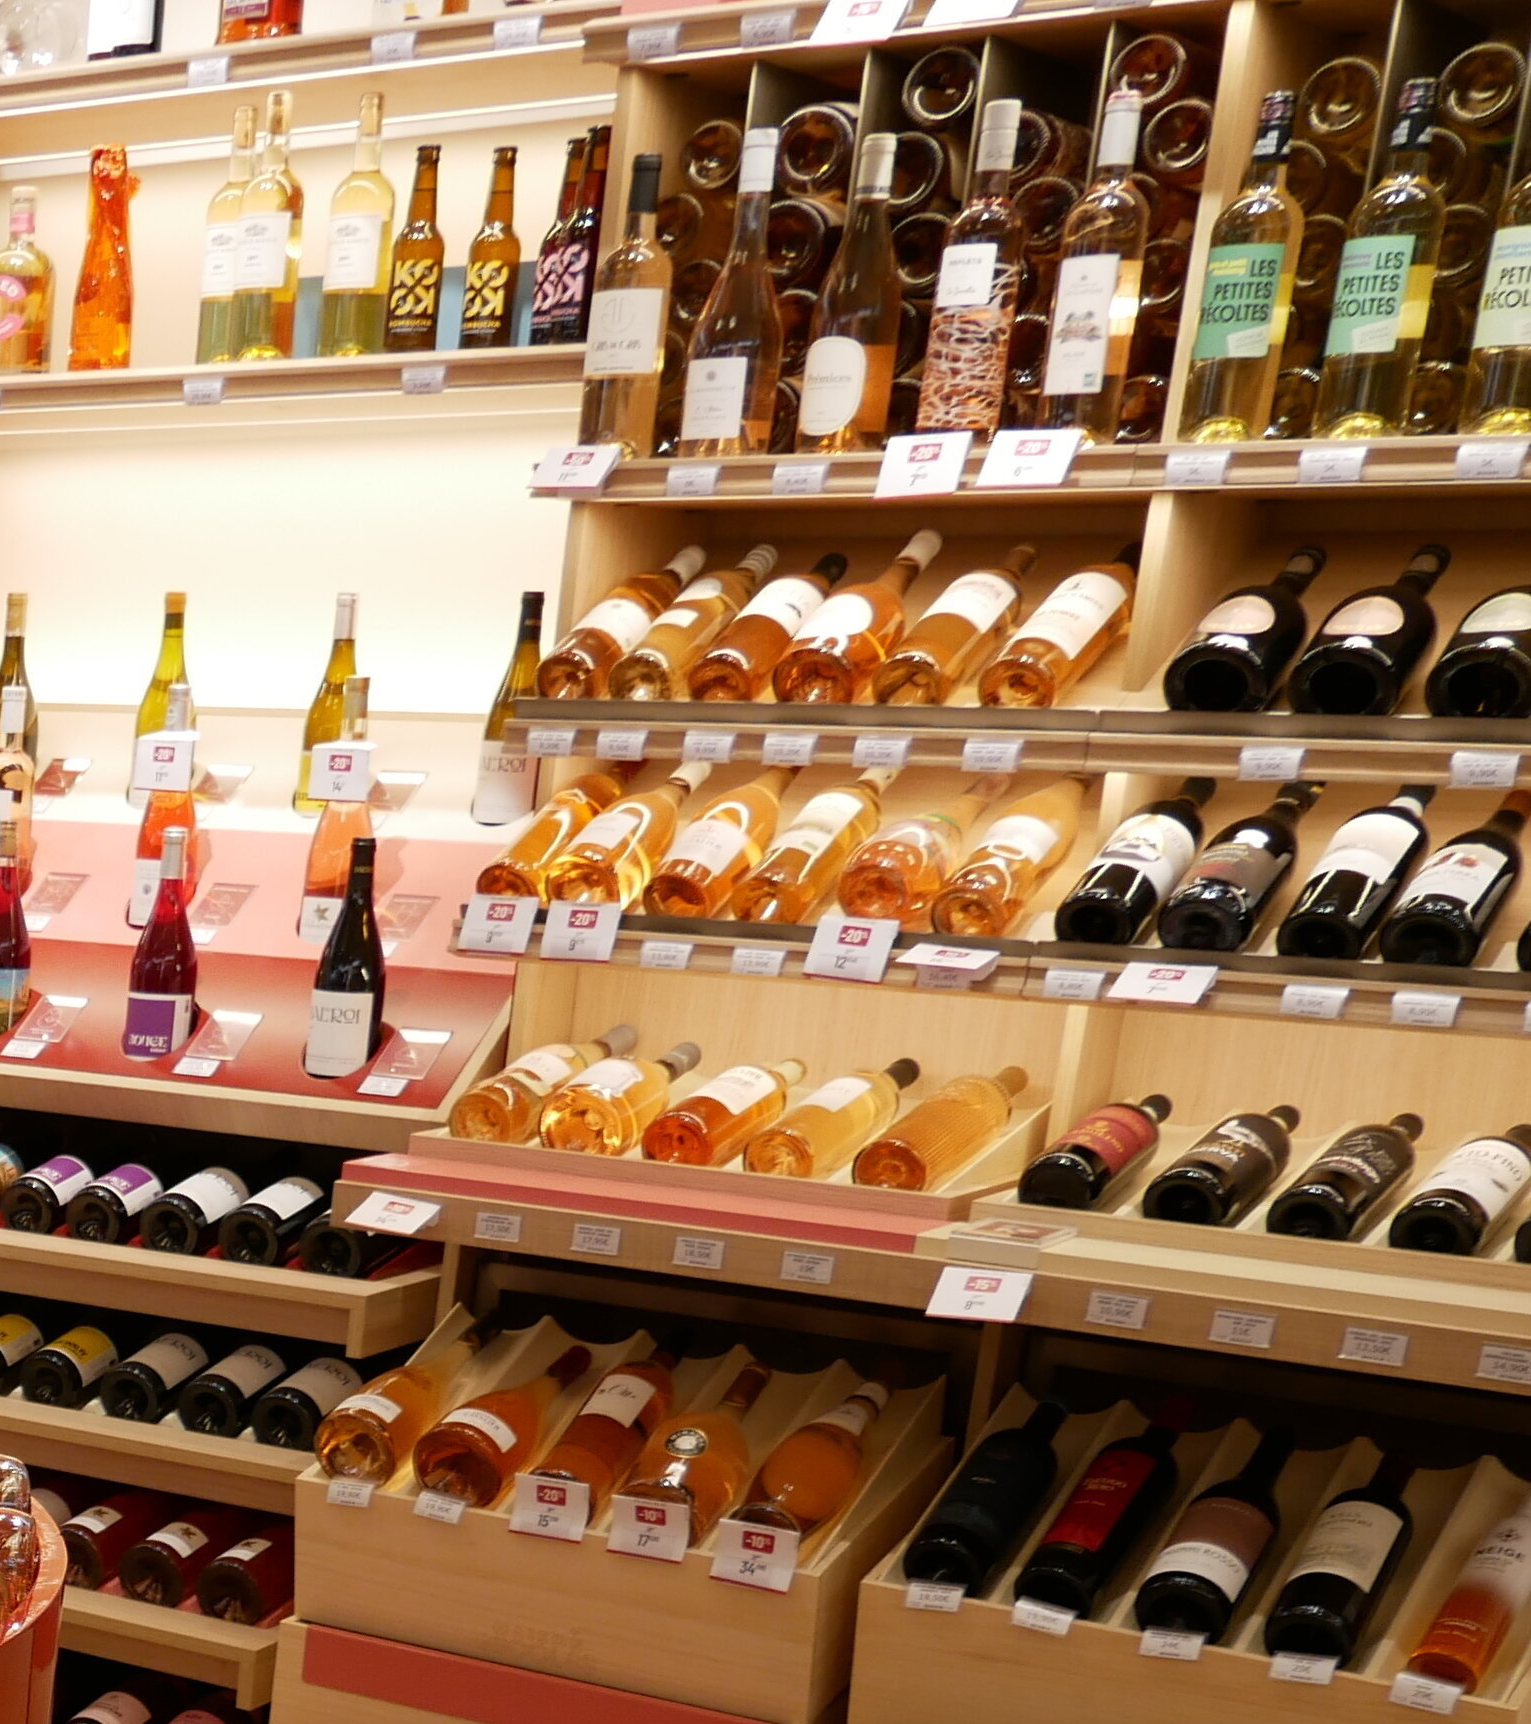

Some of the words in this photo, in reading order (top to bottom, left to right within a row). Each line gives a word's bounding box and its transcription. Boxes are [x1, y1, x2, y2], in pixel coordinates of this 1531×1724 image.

[1250, 258, 1278, 278] LES
[1375, 250, 1405, 271] LES
[1214, 281, 1274, 301] PETITES
[1343, 273, 1400, 295] PETITES
[1334, 291, 1396, 319] ÉCOLTES
[1484, 283, 1531, 311] RÉCOL
[568, 911, 598, 928] -20%
[838, 925, 869, 945] -20%
[537, 1486, 566, 1505] -20%
[636, 1507, 666, 1525] -10%
[743, 1533, 774, 1552] -10%
